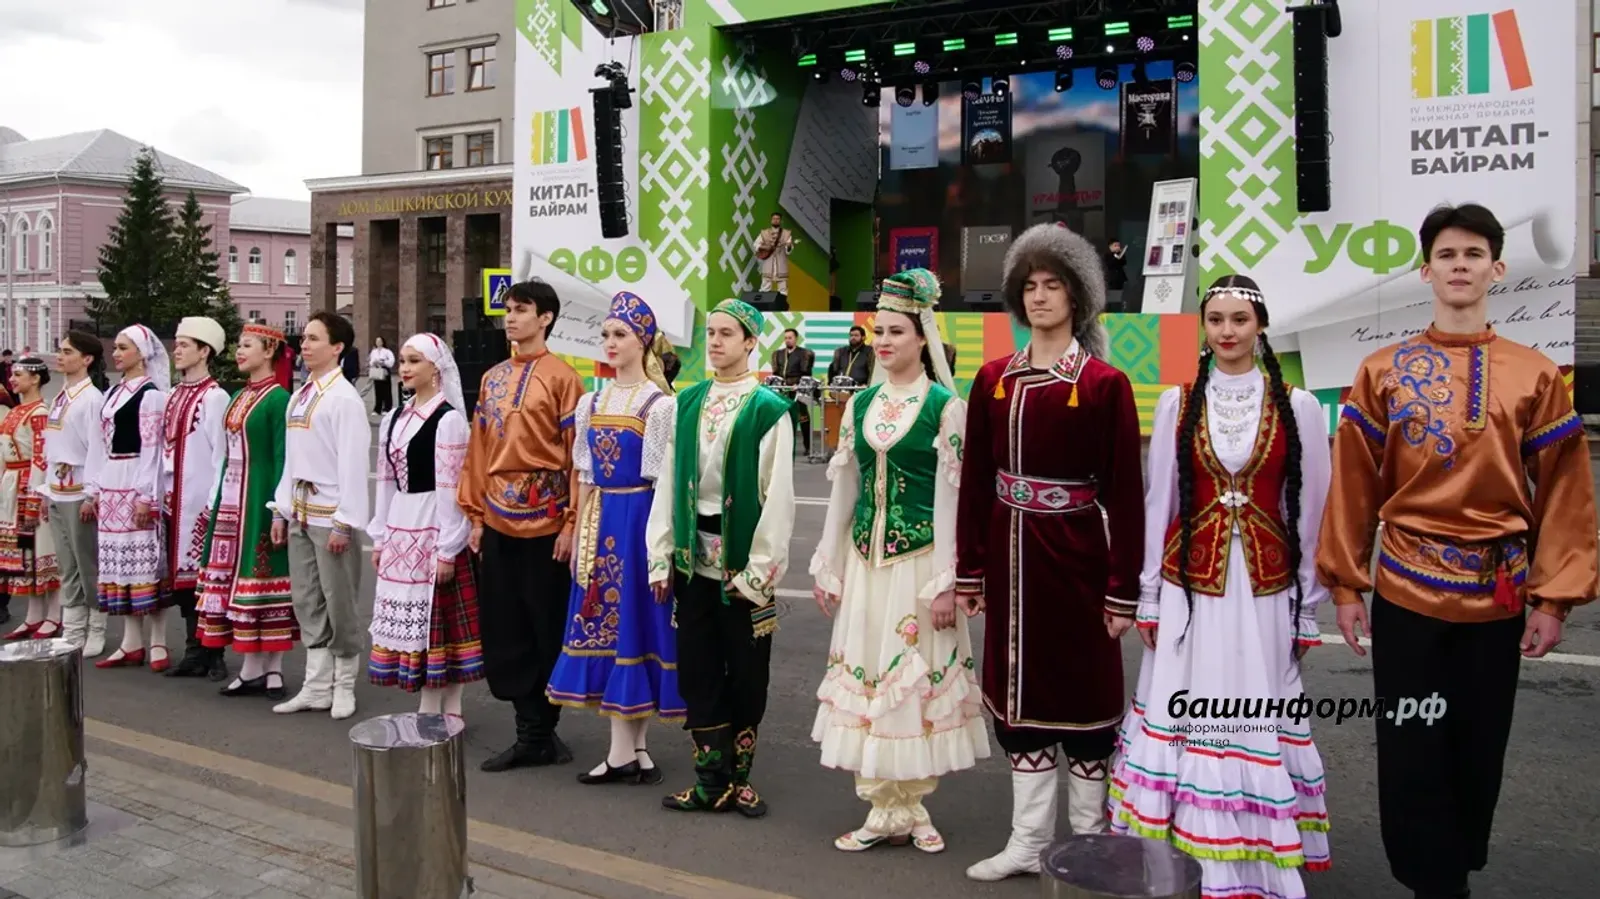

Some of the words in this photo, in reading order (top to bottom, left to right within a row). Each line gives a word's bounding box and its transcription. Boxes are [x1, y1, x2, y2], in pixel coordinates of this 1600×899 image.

[1411, 113, 1470, 123] КНИЖНАЯ
[1476, 108, 1535, 119] ЯРМАРКА
[1426, 98, 1535, 113] МЕЖДУНАРОДНАЯ
[1411, 122, 1549, 151] КИТАП-
[1411, 151, 1534, 175] БАЙРАМ
[375, 186, 478, 213] БАШКИРСКОЙ
[484, 190, 513, 206] КУХ
[530, 182, 594, 200] КИТАП-
[530, 201, 587, 217] БАЙРАМ
[1300, 219, 1423, 275] УФ
